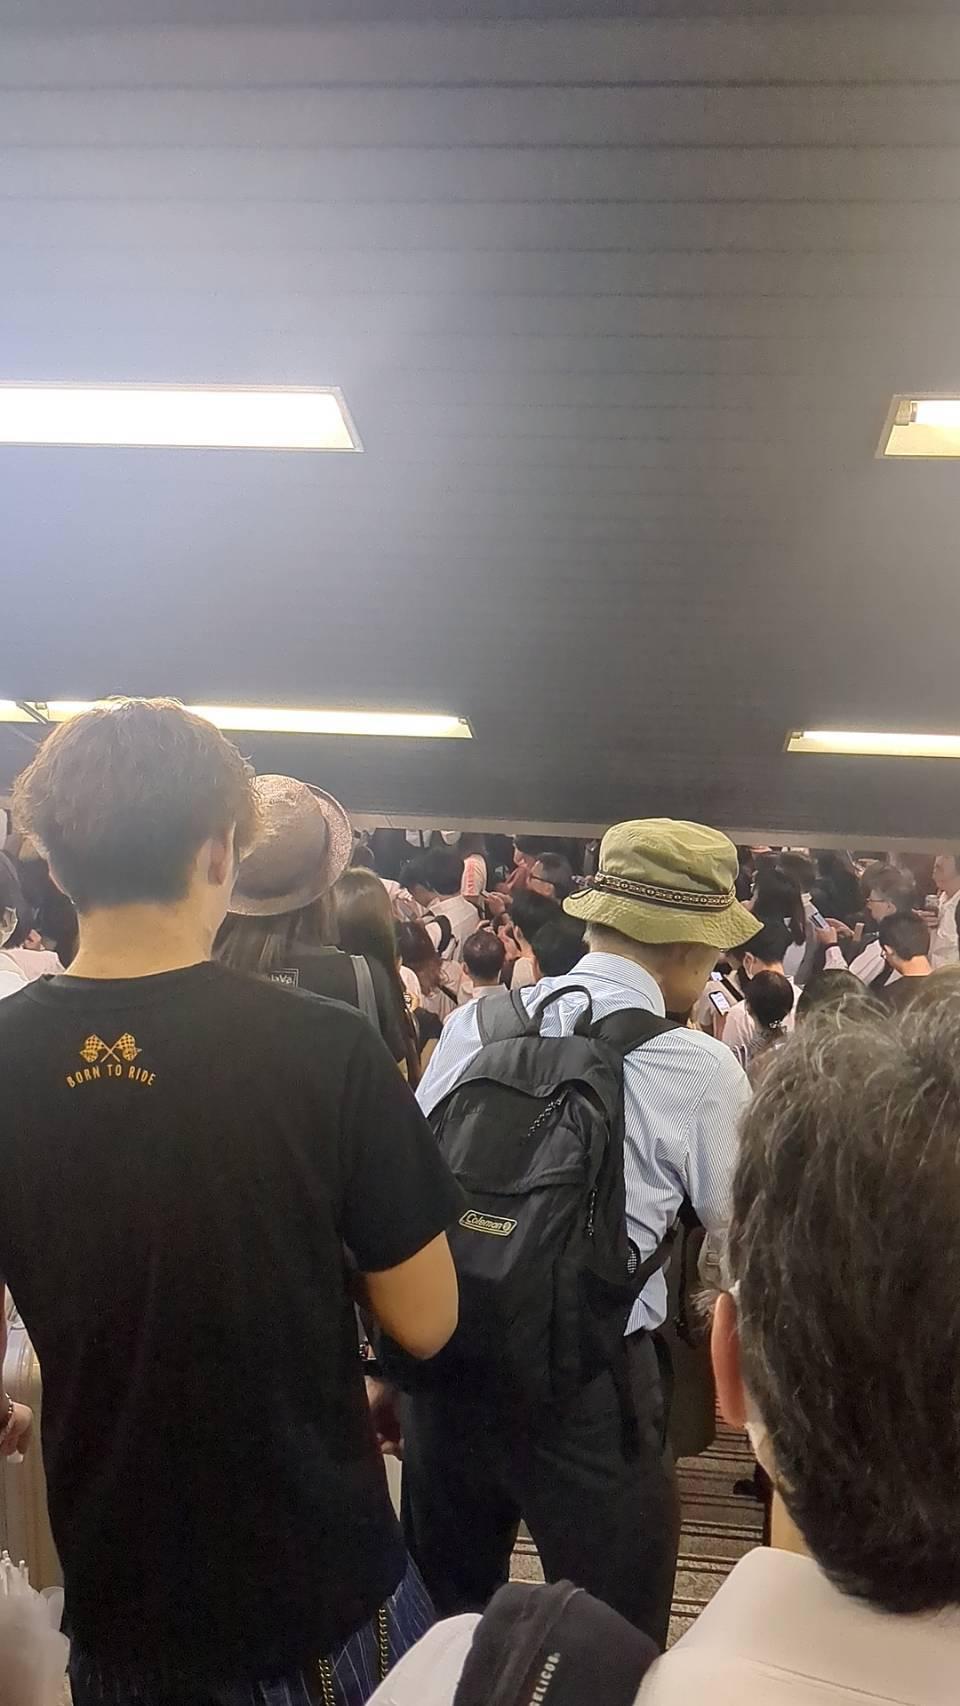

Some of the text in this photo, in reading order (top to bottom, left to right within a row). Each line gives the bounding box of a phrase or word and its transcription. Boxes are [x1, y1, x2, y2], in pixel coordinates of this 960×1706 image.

[66, 1064, 156, 1088] BORN TO RIDE
[466, 1213, 503, 1230] Coleman
